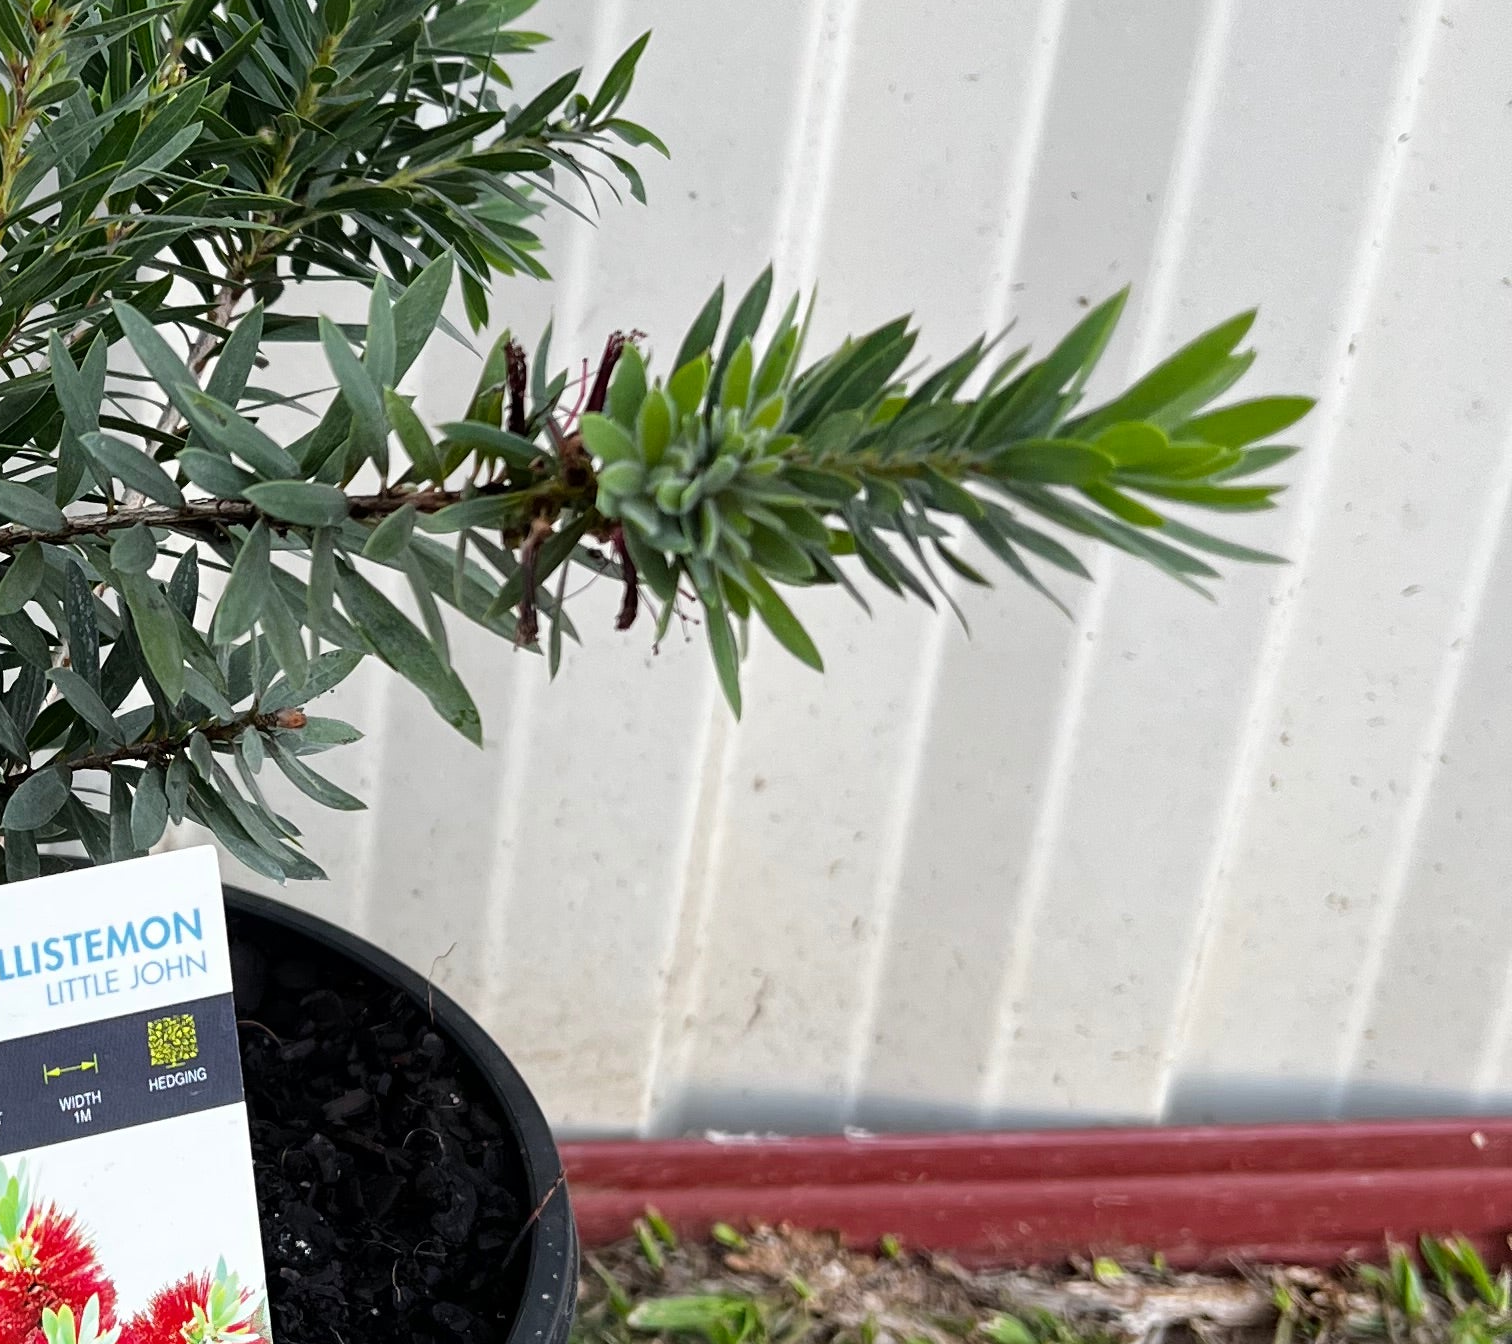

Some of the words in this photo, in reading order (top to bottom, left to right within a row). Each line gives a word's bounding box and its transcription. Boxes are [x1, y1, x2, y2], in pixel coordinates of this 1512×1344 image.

[46, 969, 120, 1007] LITTLE
[130, 951, 208, 990] JOHN
[148, 1067, 207, 1092] HEDGING
[59, 1090, 102, 1112] WIDTH
[73, 1108, 92, 1124] 1M
